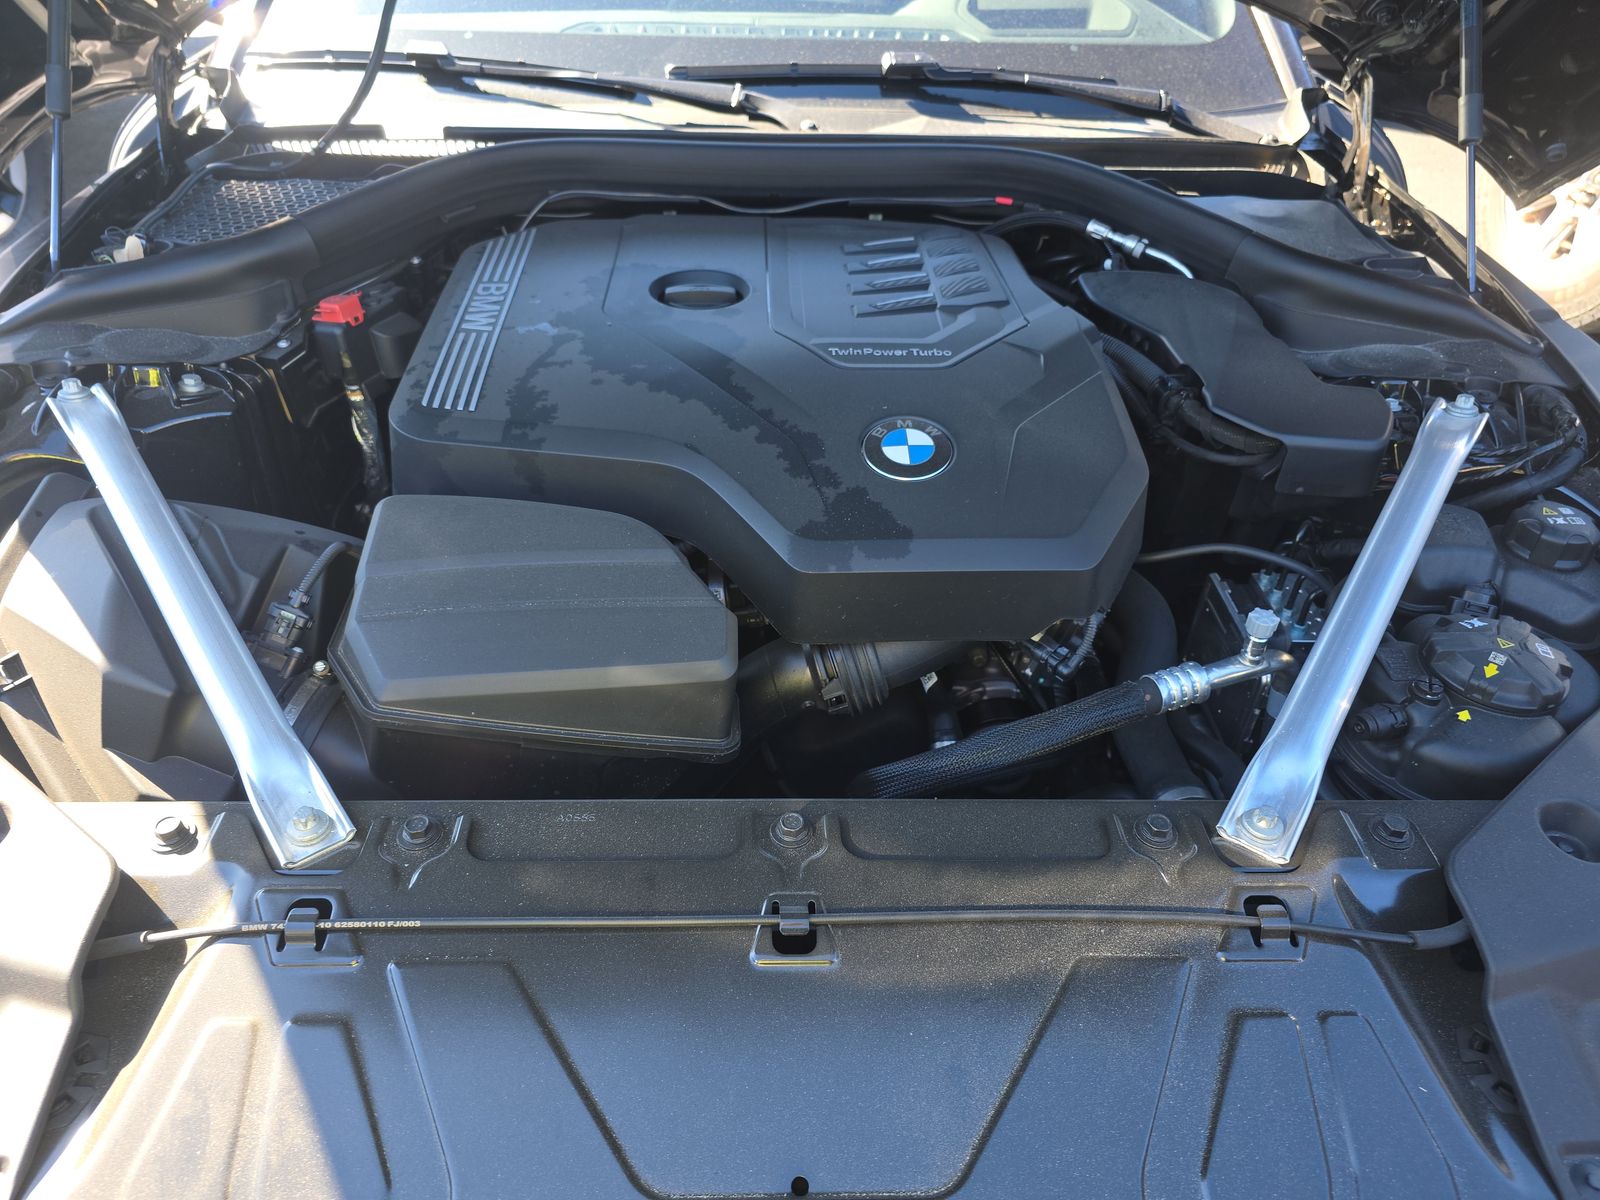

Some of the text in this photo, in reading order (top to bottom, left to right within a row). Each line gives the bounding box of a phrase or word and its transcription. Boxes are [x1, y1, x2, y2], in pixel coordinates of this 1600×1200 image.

[461, 283, 509, 331] BMW
[909, 348, 952, 357] Turbo
[872, 420, 942, 437] BMW
